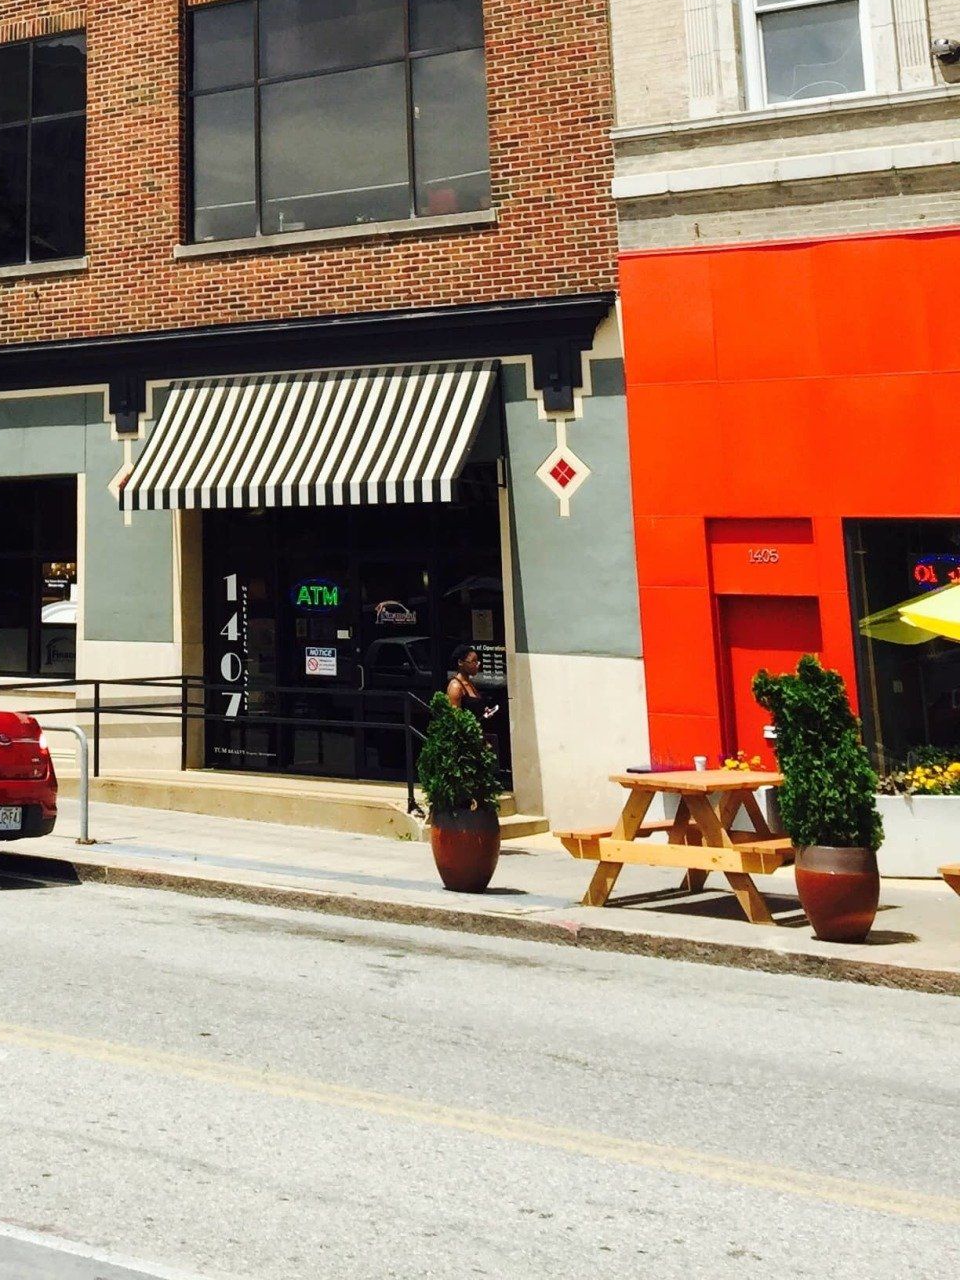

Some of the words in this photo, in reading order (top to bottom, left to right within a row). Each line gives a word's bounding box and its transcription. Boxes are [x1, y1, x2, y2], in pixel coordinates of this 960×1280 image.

[748, 548, 780, 563] 1405
[296, 585, 338, 606] ATM
[219, 573, 242, 717] 1407
[309, 648, 332, 657] NOTICE
